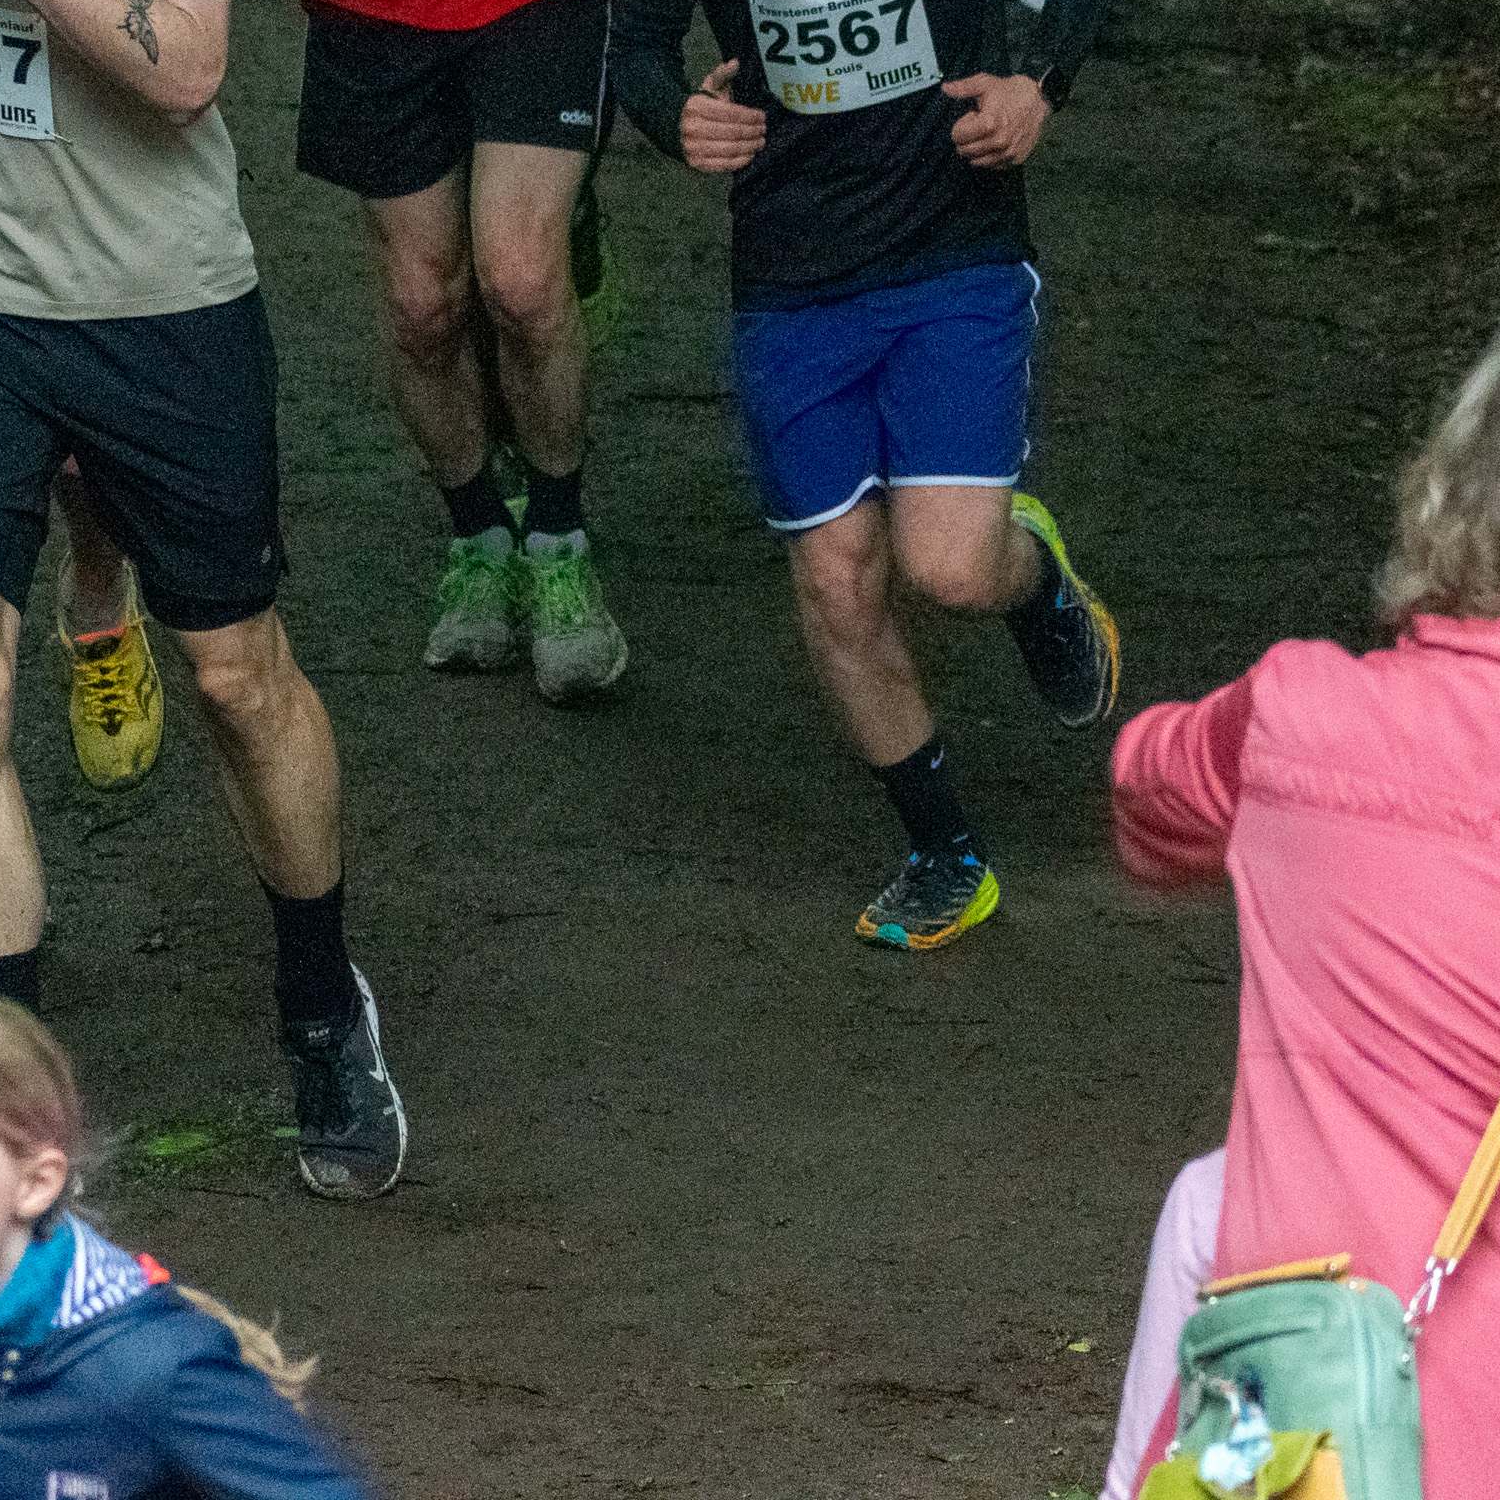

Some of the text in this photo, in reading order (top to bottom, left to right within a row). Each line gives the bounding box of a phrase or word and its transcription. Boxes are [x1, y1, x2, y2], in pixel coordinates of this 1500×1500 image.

[758, 4, 824, 19] Everstener
[825, 62, 863, 77] Louis
[866, 61, 923, 91] bruns
[782, 80, 841, 105] EWE
